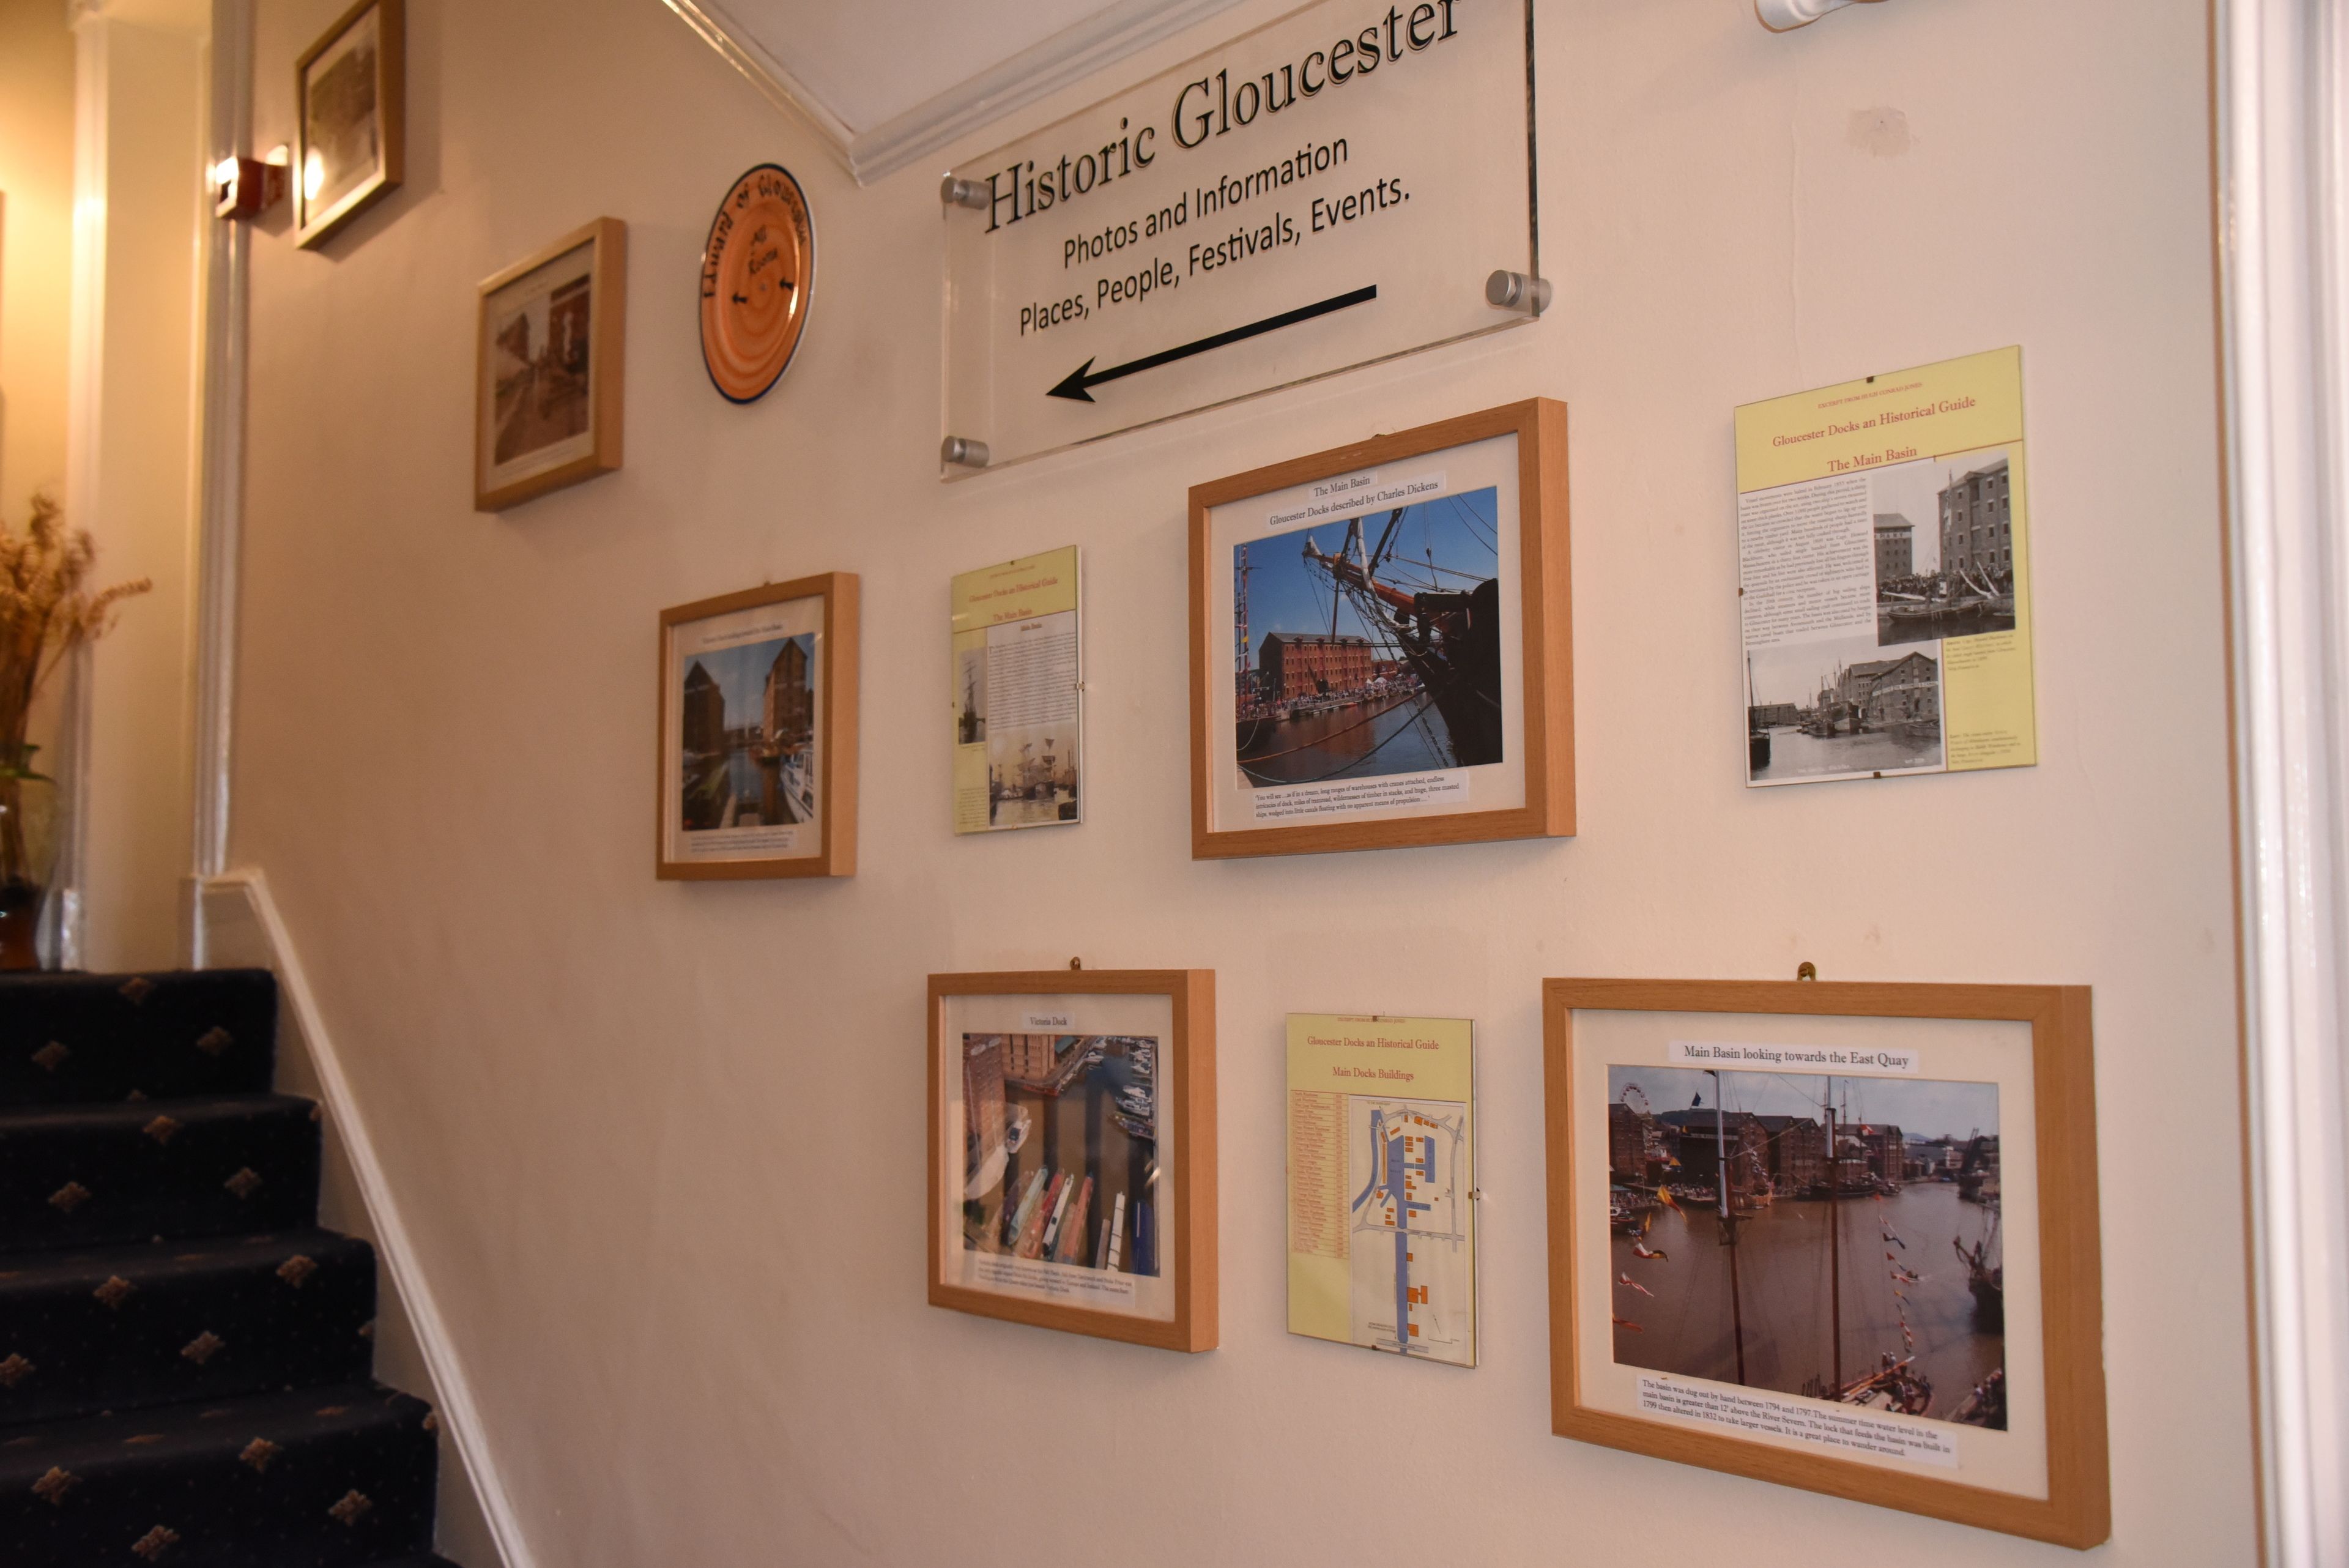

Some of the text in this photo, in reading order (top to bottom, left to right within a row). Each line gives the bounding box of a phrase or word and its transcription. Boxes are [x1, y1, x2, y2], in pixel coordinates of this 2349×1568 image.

[984, 0, 1461, 234] Historic Gloucester
[1064, 138, 1348, 269] Photos and Information
[1020, 177, 1409, 336] Places, People, Festivals, Events.
[1772, 396, 1976, 447] Gloucester Docks an Historical Guide
[1827, 447, 1917, 472] The Main Basin
[1269, 481, 1439, 526] Gloucester Docks described by Charles Dickens
[1313, 477, 1370, 497] The Main Basin
[1307, 1036, 1342, 1047] Gloucester
[1343, 1037, 1365, 1047] Docks
[1377, 1038, 1414, 1049] Historical
[1416, 1039, 1439, 1050] Guide
[1684, 1046, 1909, 1069] Main Basin looking towards the East Quay
[1332, 1066, 1414, 1082] Main Docks Buildings
[1642, 1379, 1655, 1389] The
[1656, 1380, 1672, 1391] basin
[1685, 1388, 1698, 1398] dug
[1711, 1392, 1718, 1402] by
[1720, 1393, 1735, 1403] hand
[1737, 1395, 1764, 1408] between
[1765, 1401, 1780, 1411] 1794
[1781, 1404, 1794, 1414] and
[1828, 1414, 1857, 1425] summer
[1876, 1423, 1896, 1433] water
[1898, 1425, 1915, 1435] level
[1915, 1429, 1924, 1437] in
[1926, 1430, 1938, 1439] the
[1642, 1391, 1658, 1399] main
[1659, 1392, 1674, 1402] basin
[1682, 1398, 1704, 1408] greater
[1704, 1401, 1719, 1410] than
[1731, 1405, 1749, 1416] above
[1750, 1410, 1761, 1419] the
[1762, 1412, 1781, 1422] River
[1808, 1420, 1822, 1430] The
[1824, 1422, 1838, 1433] lock
[1839, 1426, 1854, 1436] that
[1874, 1432, 1886, 1441] the
[1923, 1441, 1941, 1452] built
[1942, 1445, 1951, 1454] in
[1643, 1400, 1657, 1410] 1799
[1658, 1402, 1672, 1413] then
[1673, 1405, 1694, 1416] altered
[1694, 1409, 1701, 1418] in
[1702, 1411, 1717, 1421] 1832
[1726, 1416, 1739, 1425] take
[1740, 1418, 1759, 1429] larger
[1785, 1427, 1792, 1435] It
[1792, 1428, 1798, 1436] is
[1805, 1430, 1821, 1441] great
[1823, 1433, 1841, 1444] place
[1842, 1437, 1850, 1446] to
[1851, 1440, 1877, 1451] wander
